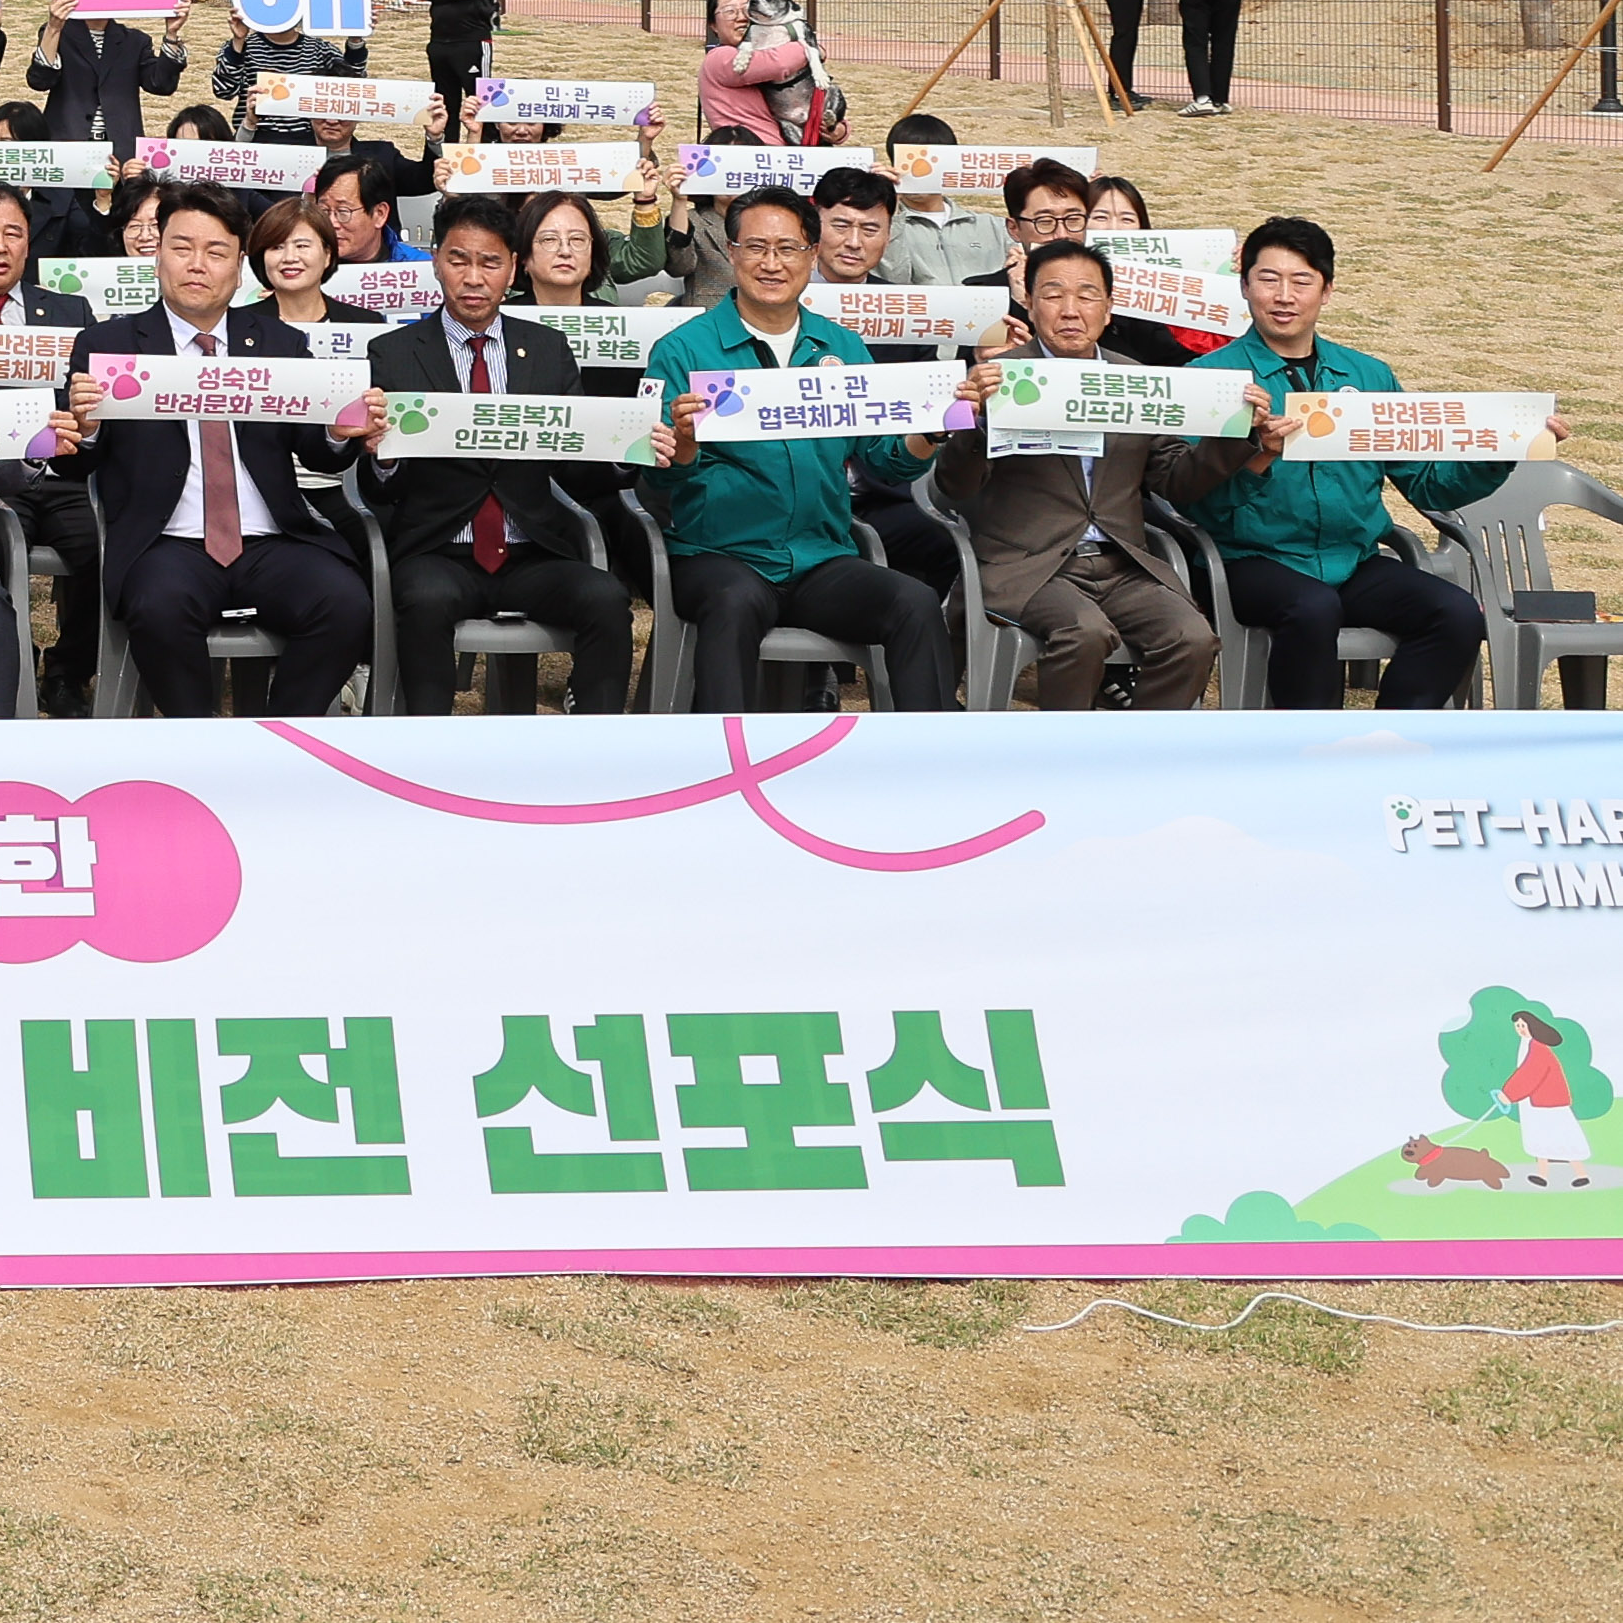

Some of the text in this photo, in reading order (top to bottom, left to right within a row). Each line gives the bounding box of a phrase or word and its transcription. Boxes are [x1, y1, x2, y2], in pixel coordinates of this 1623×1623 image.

[314, 82, 377, 99] 반려동물
[365, 100, 396, 117] 구축
[517, 102, 616, 120] 협력체계 구축
[208, 148, 258, 165] 성숙한
[507, 149, 577, 165] 반려동물
[32, 167, 65, 183] 확충
[251, 168, 285, 185] 확산
[492, 169, 602, 186] 돌봄체계 구축
[360, 270, 419, 290] 성숙한
[1113, 264, 1204, 297] 반려동물
[840, 292, 927, 315] 반려동물
[1185, 299, 1230, 327] 구축
[911, 318, 955, 339] 구축
[597, 340, 641, 361] 확충
[197, 367, 272, 392] 성숙한
[1079, 372, 1172, 399] 동물복지
[154, 393, 311, 417] 반려문화 확산
[472, 403, 573, 429] 동물복지
[757, 400, 914, 431] 협력체계 구축
[1065, 398, 1186, 427] 인프라 확충
[1371, 401, 1465, 425] 반려동물
[455, 428, 586, 454] 인프라 확충
[1348, 428, 1499, 453] 돌봄체계 구축
[1506, 860, 1623, 909] GIM
[19, 1014, 413, 1200] 비전
[471, 1007, 1068, 1194] 선포식
